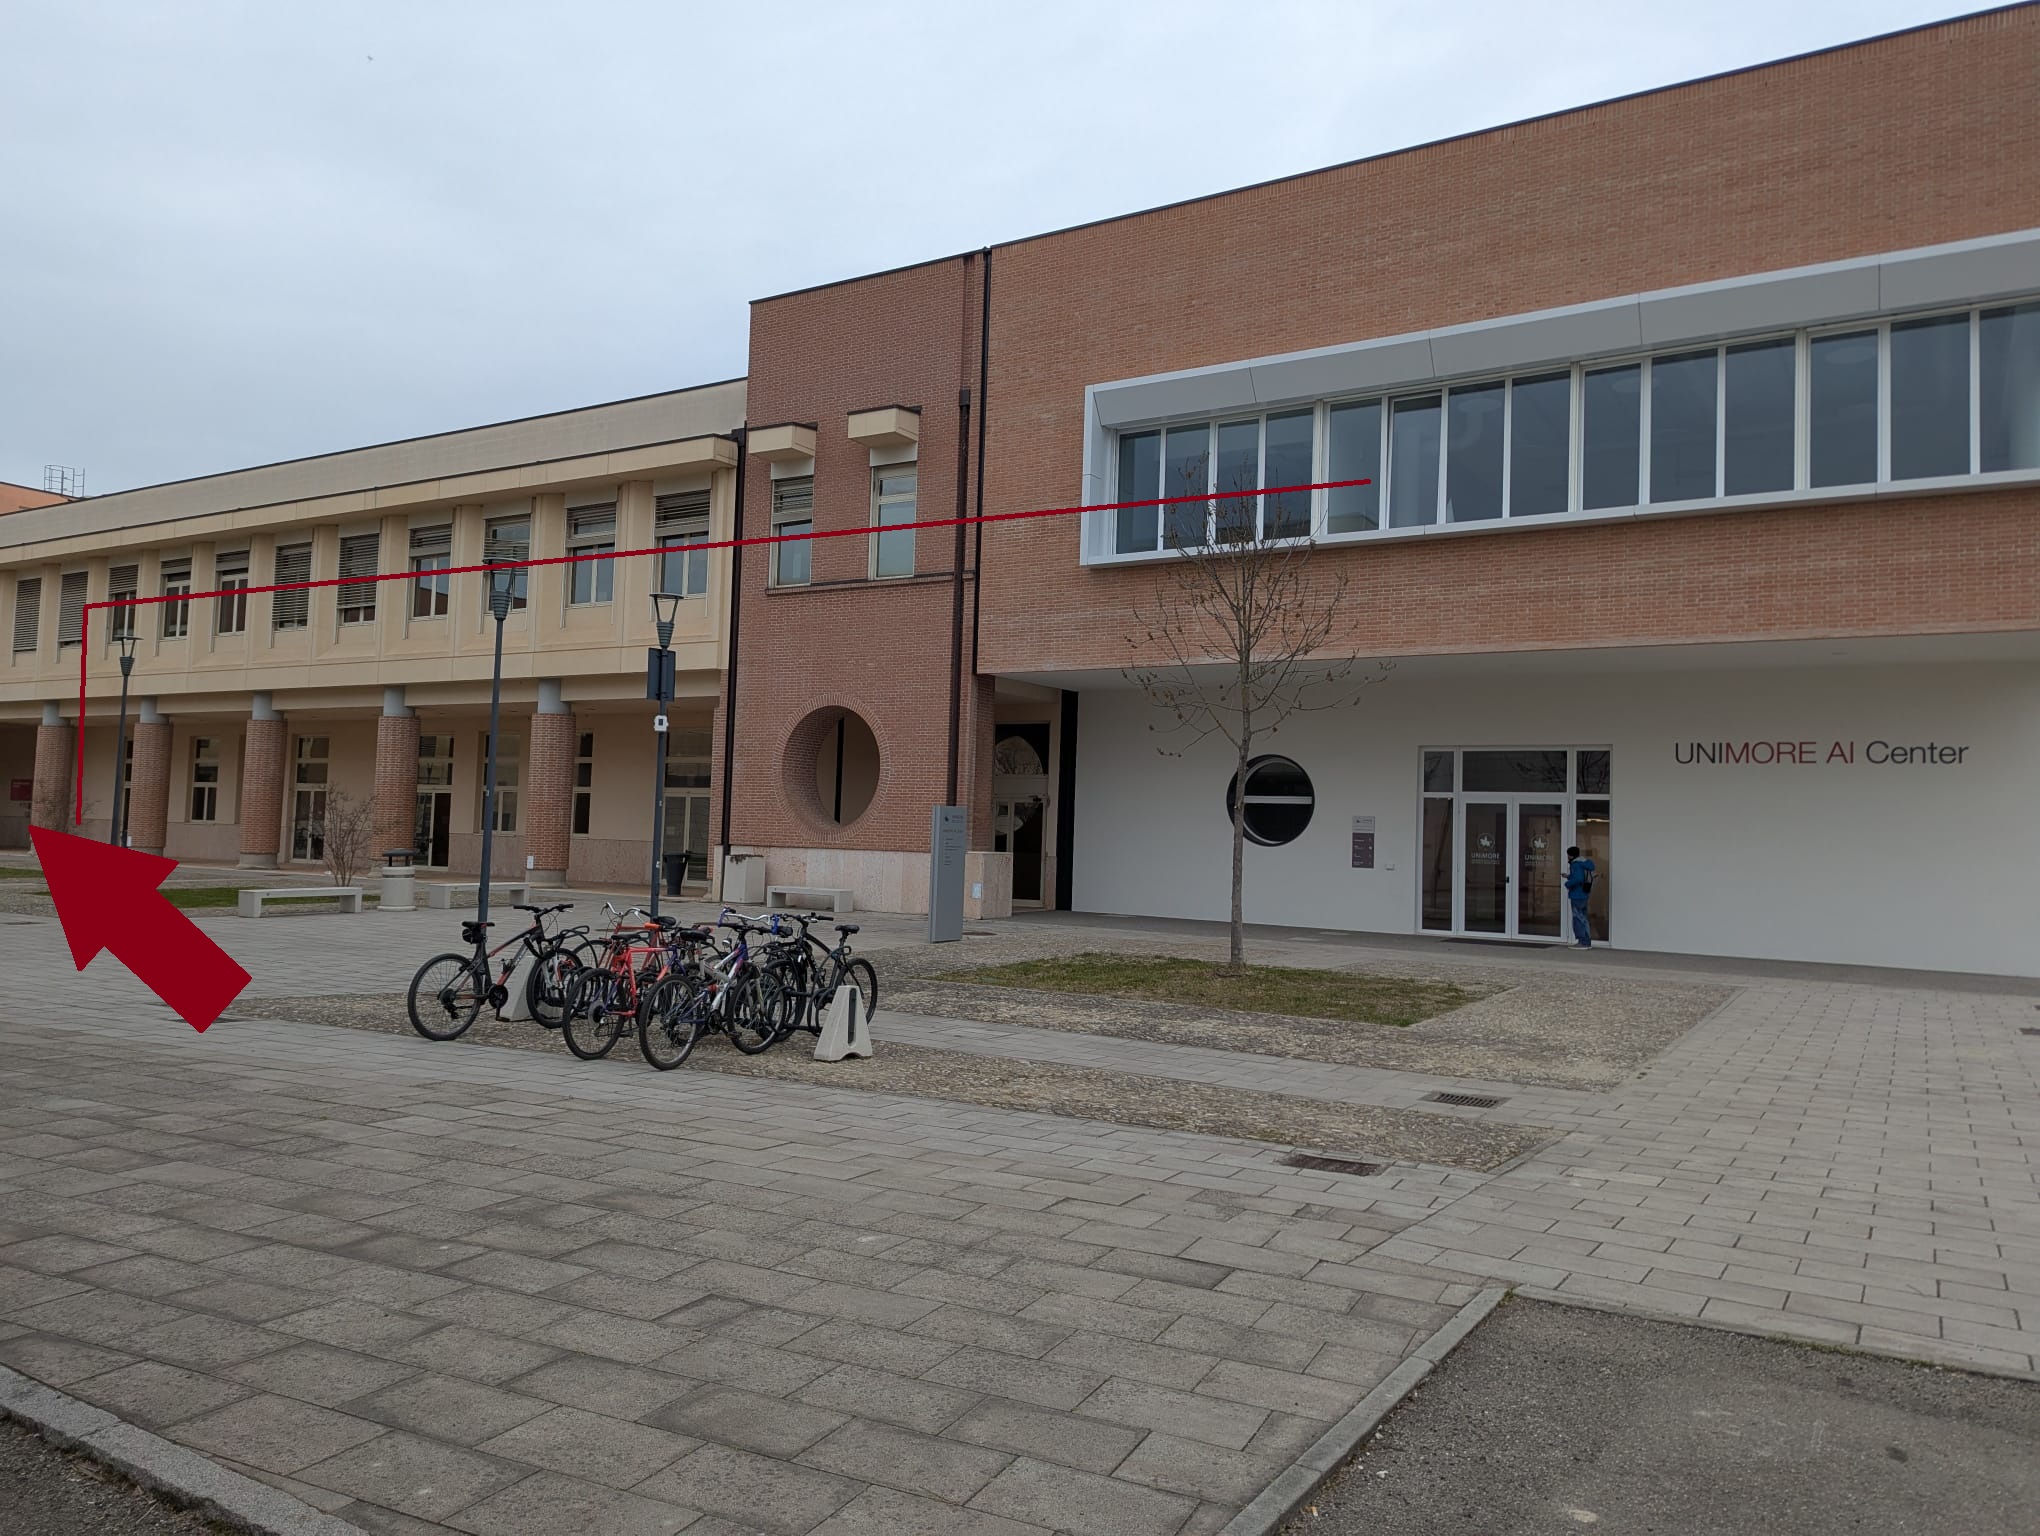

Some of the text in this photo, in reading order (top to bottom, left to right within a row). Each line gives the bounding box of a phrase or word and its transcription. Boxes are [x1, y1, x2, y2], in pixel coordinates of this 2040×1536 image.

[1674, 740, 1970, 765] UNIMORE AI Center
